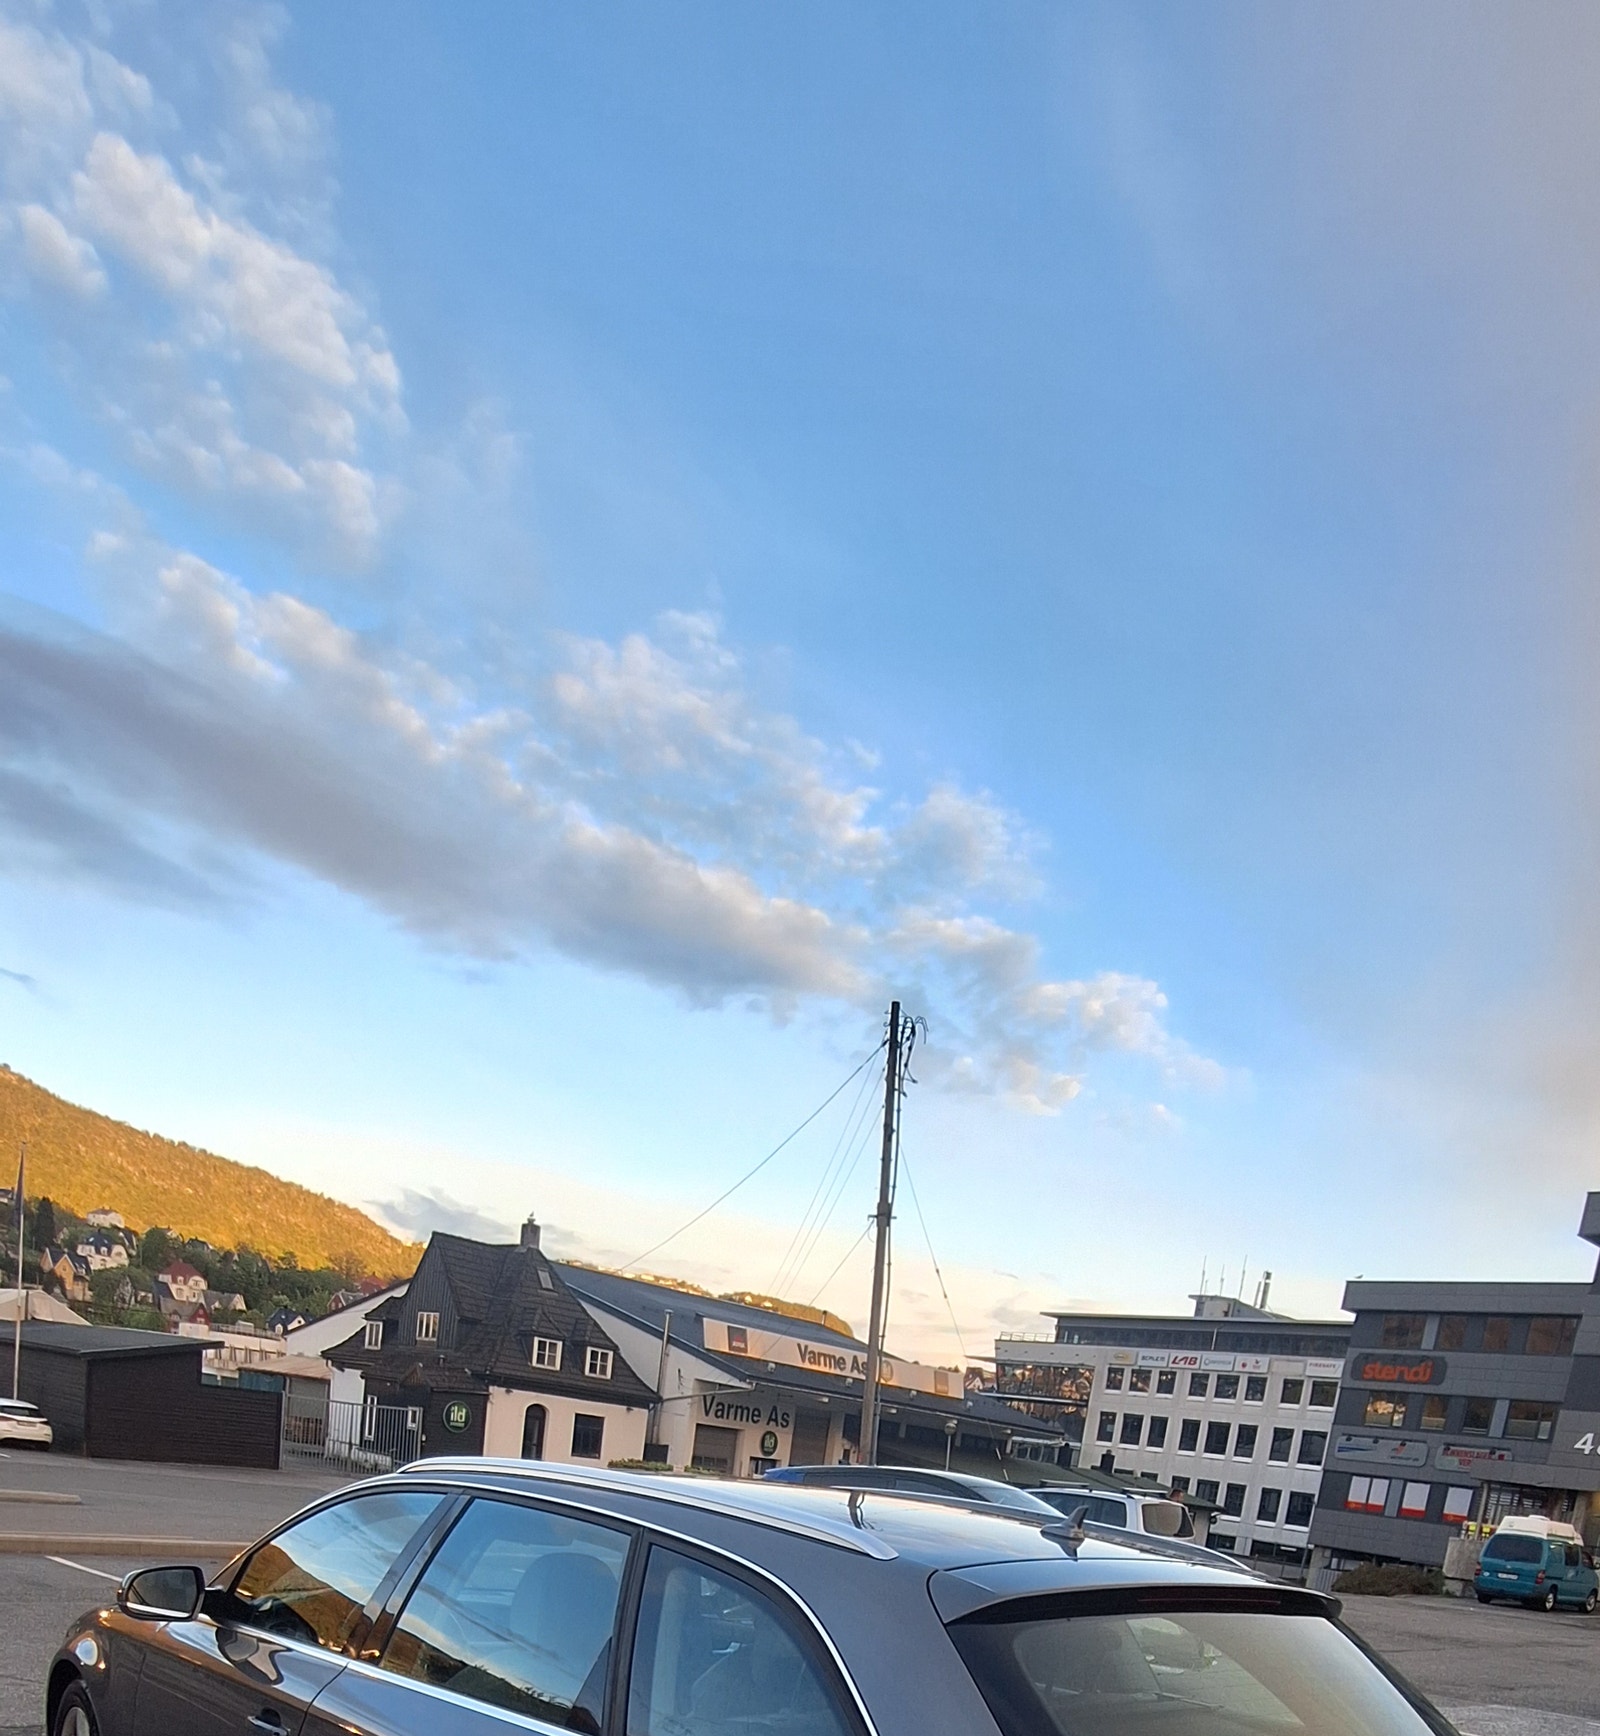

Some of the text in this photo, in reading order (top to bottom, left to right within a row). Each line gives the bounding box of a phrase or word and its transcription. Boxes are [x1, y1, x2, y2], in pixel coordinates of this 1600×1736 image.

[797, 1343, 847, 1372] Varme
[850, 1355, 868, 1376] As
[1171, 1355, 1199, 1366] LAB
[1362, 1360, 1435, 1385] stendi
[450, 1405, 467, 1422] ild
[702, 1394, 790, 1428] Varme As
[1573, 1432, 1600, 1456] 4
